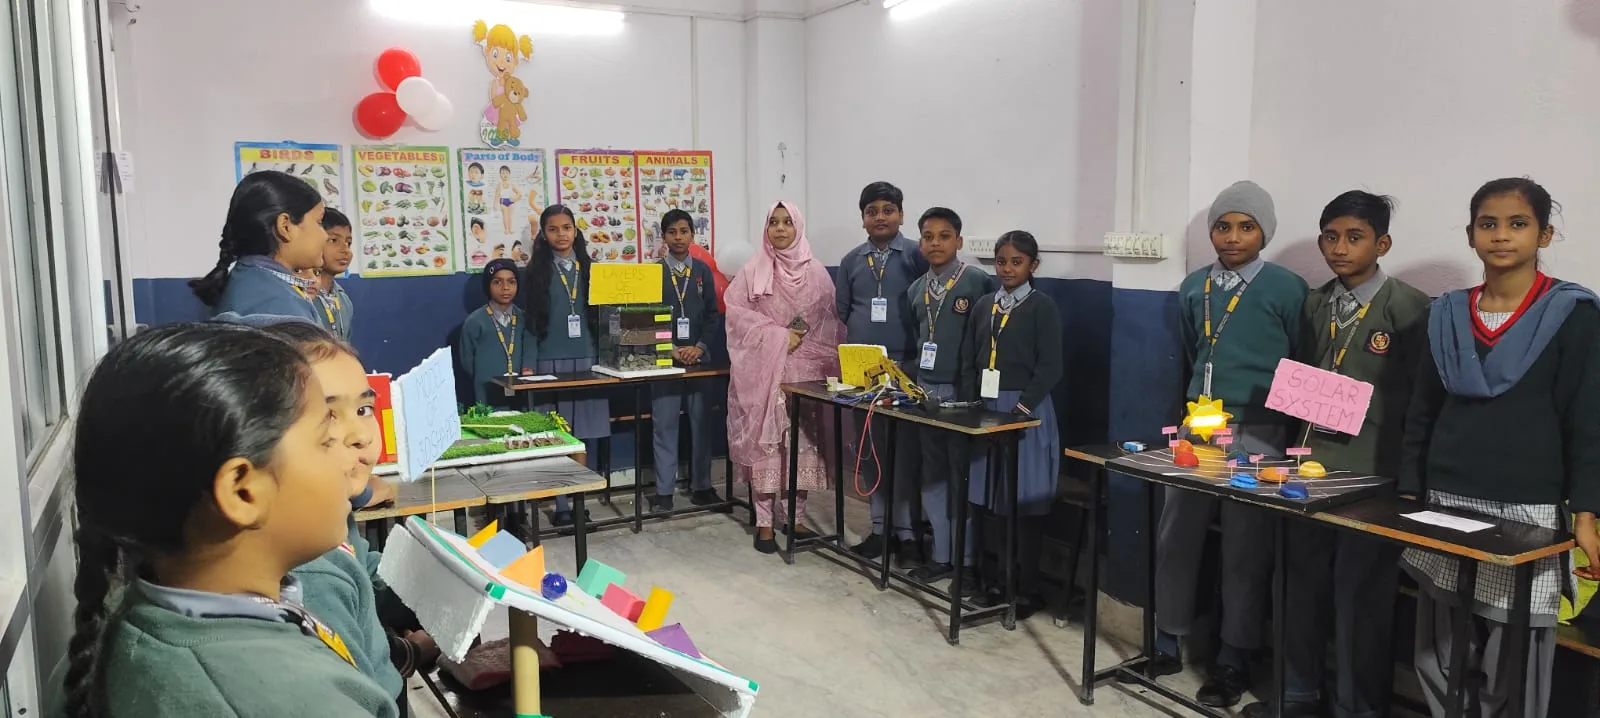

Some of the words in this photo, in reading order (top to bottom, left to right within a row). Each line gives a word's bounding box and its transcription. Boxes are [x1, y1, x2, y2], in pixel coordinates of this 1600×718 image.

[259, 149, 315, 160] BIRDS
[358, 151, 439, 162] VEGETABLES
[464, 152, 495, 162] Parts
[497, 152, 511, 162] of
[571, 155, 620, 164] FRUITS
[646, 155, 698, 165] ANIMALS
[602, 267, 646, 281] LAYERS
[616, 280, 633, 292] OF
[415, 361, 446, 402] MODEL
[1287, 367, 1360, 405] SOLAR
[1271, 387, 1354, 429] SYSTEM
